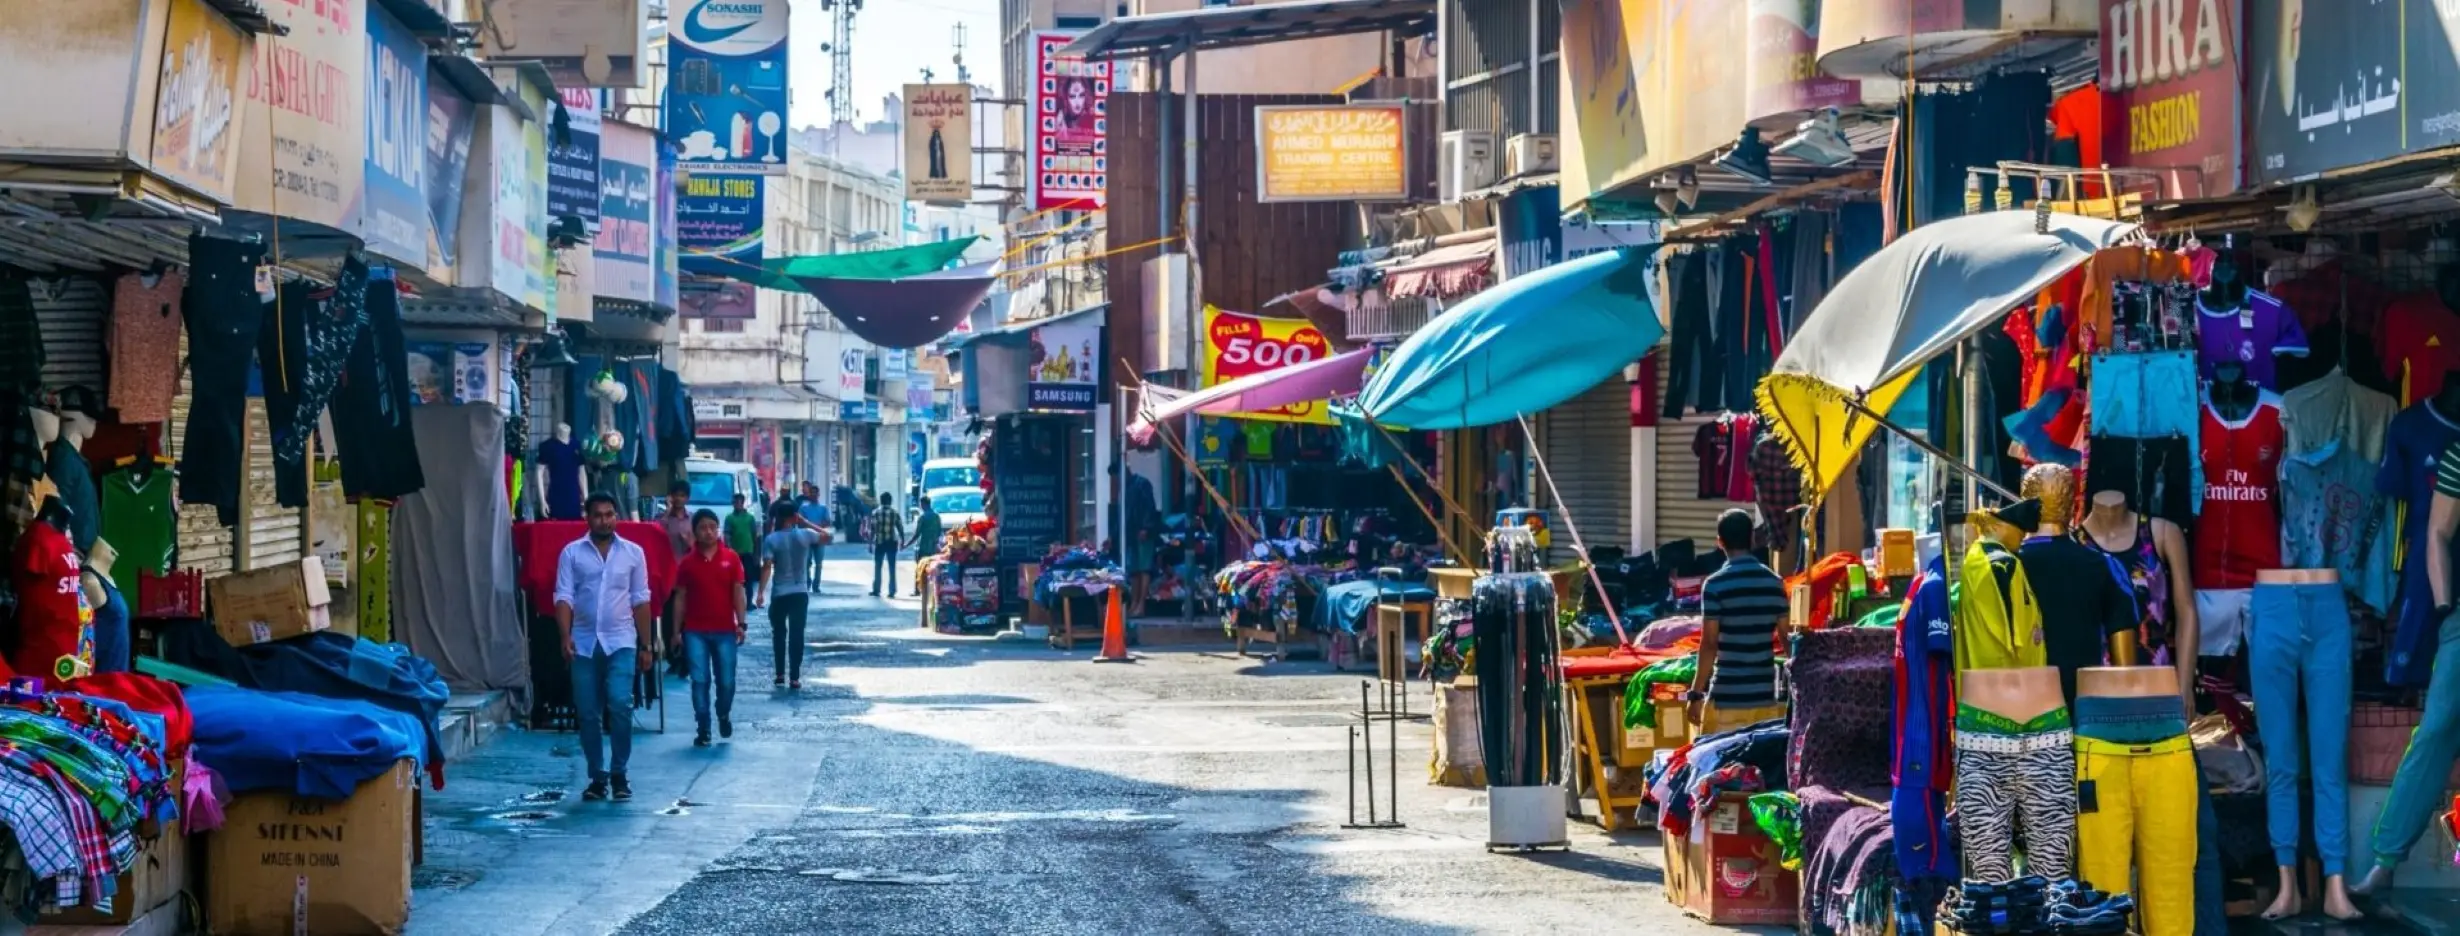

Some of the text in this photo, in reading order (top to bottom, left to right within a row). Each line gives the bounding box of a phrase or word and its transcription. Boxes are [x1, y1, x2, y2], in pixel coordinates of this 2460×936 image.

[706, 3, 764, 14] SONASHI
[2109, 0, 2224, 92] HIRA
[364, 31, 425, 196] NOKIA
[2129, 90, 2201, 155] FASHION
[1273, 135, 1325, 150] AHMED
[1276, 151, 1393, 165] TRADING CENTRE
[713, 163, 769, 171] ELECTRONICS
[724, 179, 756, 199] STORES
[1216, 322, 1251, 337] FILLS
[1296, 333, 1320, 346] Only
[1223, 337, 1311, 367] 500
[1034, 389, 1092, 402] SAMSUNG
[1716, 444, 1728, 466] 7
[1005, 475, 1020, 485] ALL
[2225, 468, 2248, 485] Fly
[2204, 481, 2268, 502] Emirates
[1005, 518, 1055, 529] HARDWARE
[1976, 711, 2024, 732] LACOSTE
[261, 852, 340, 867] MADE IN CHINA
